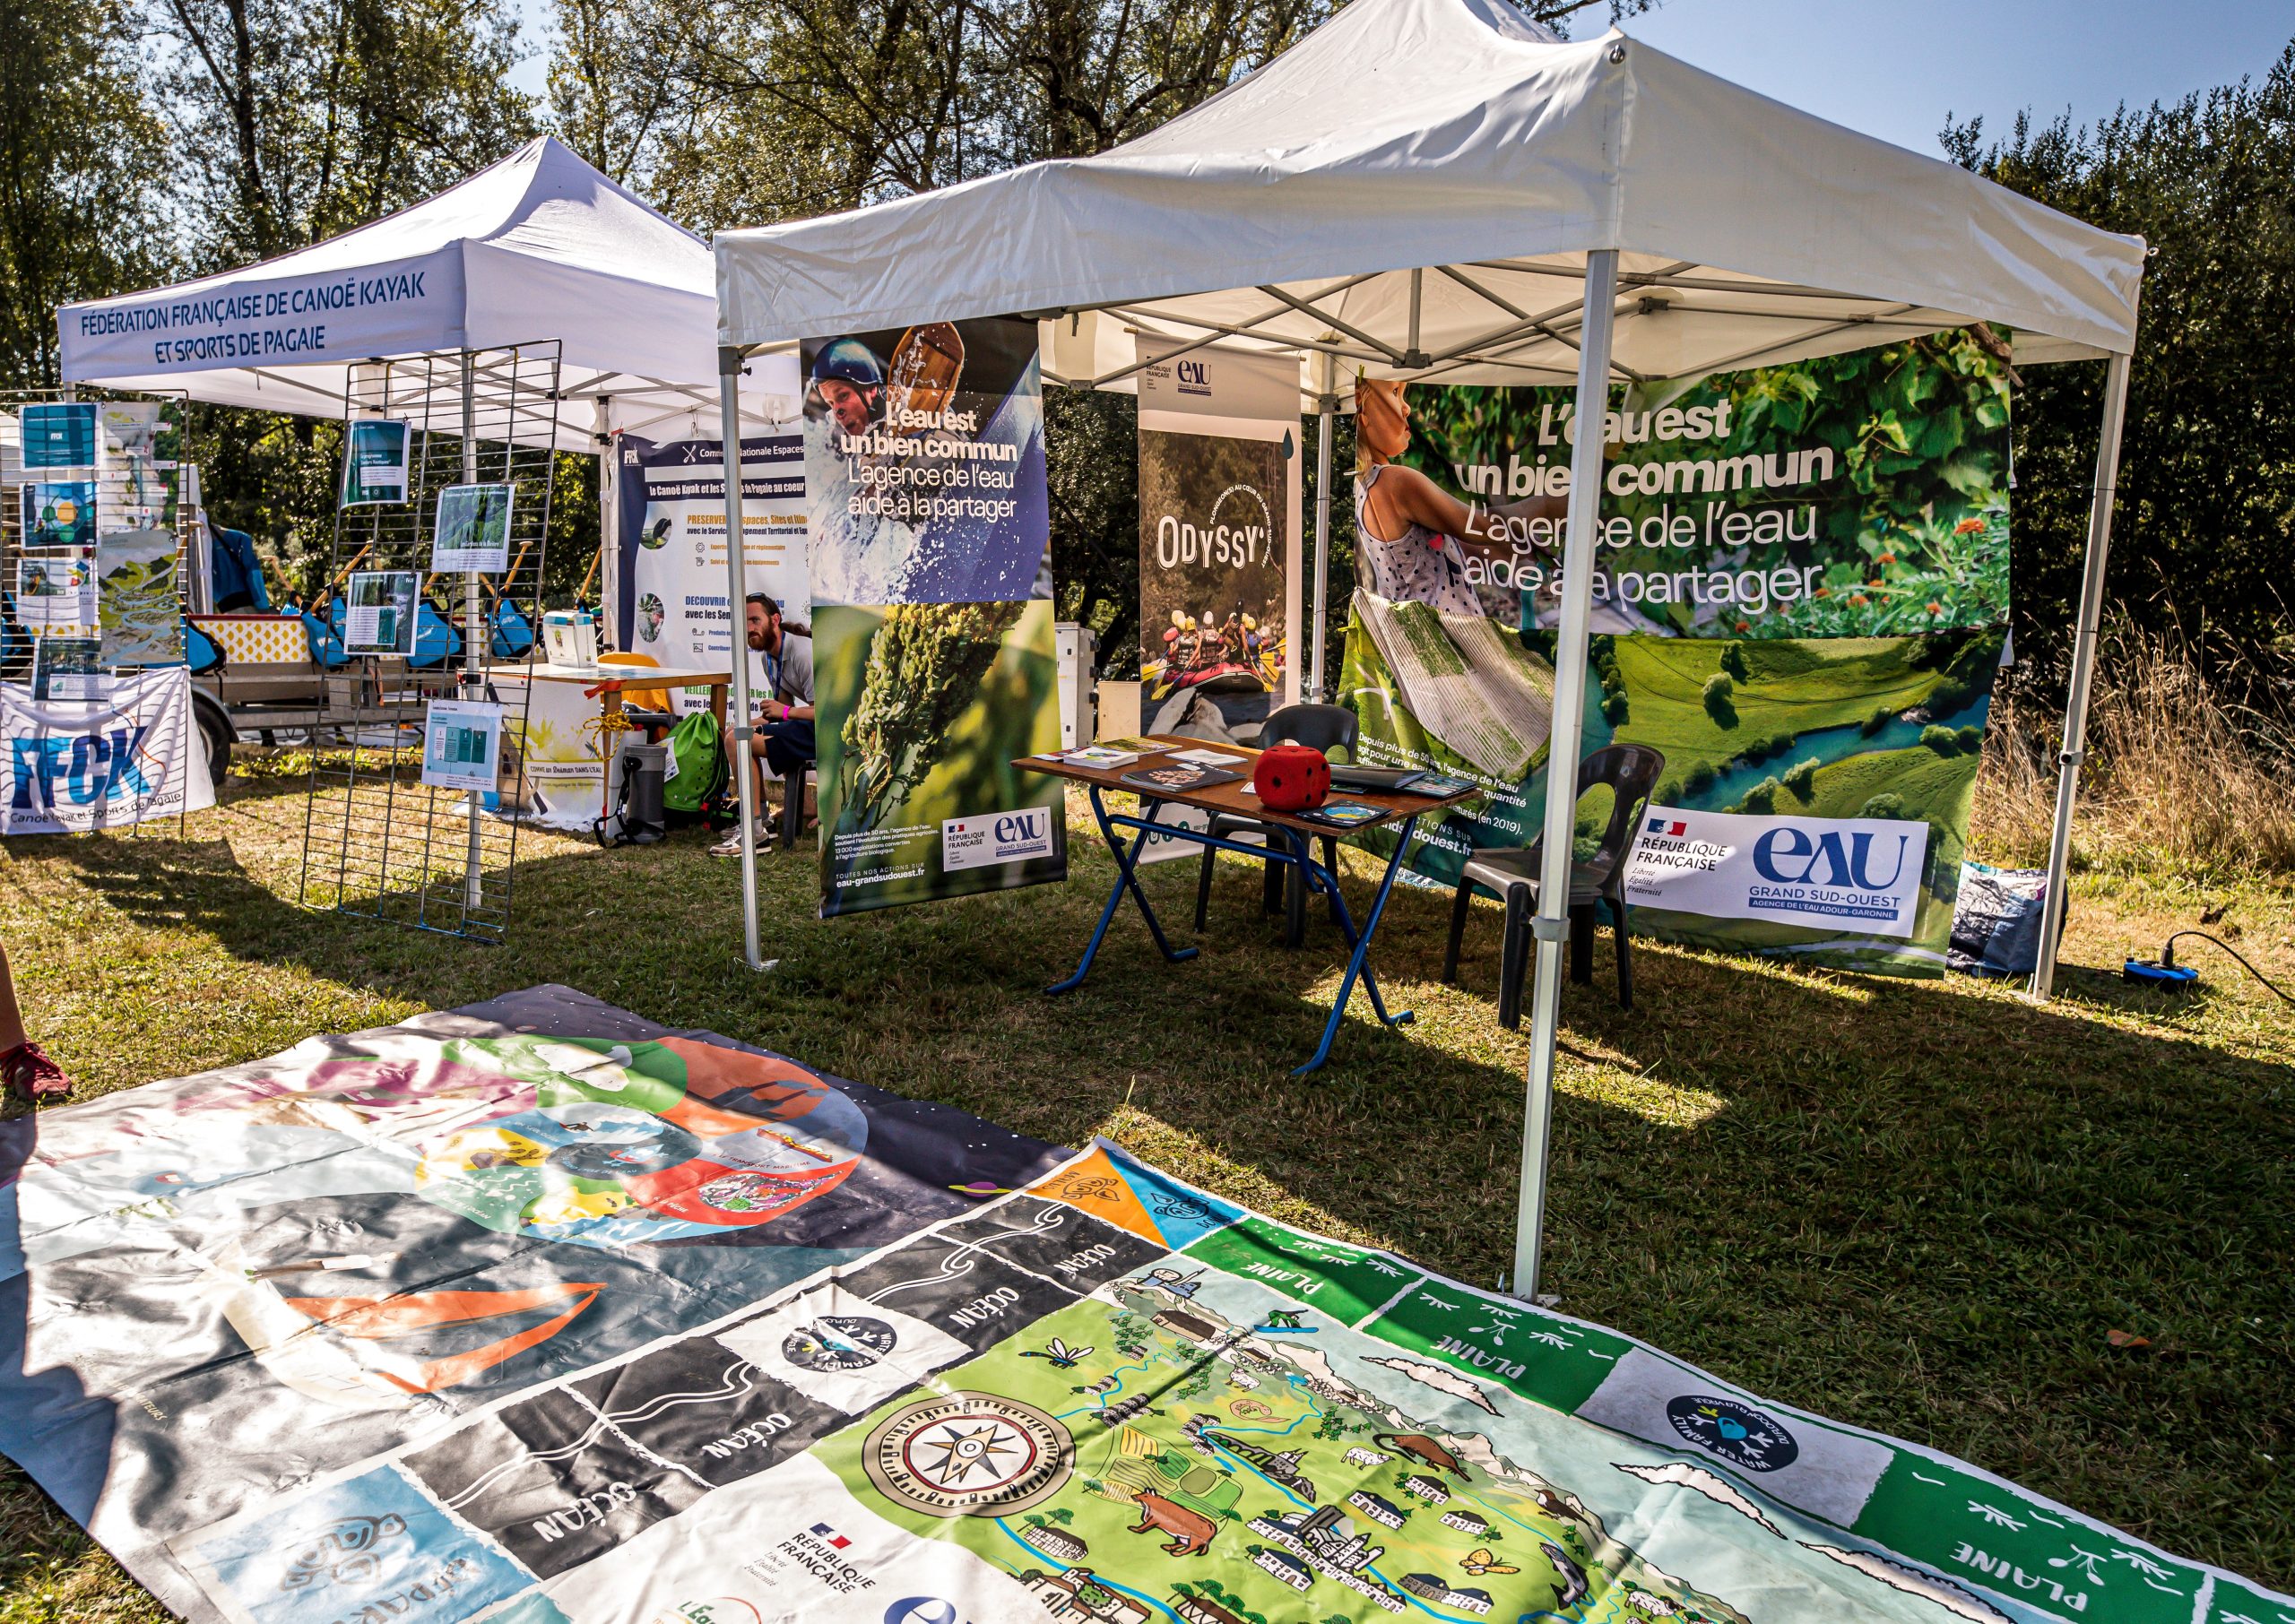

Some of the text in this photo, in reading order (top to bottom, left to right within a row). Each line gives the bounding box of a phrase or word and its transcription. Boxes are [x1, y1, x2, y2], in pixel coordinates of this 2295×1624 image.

[82, 272, 425, 336] FÉDÉRATION FRANÇAISE DE CANOË KAYAK
[155, 326, 325, 363] ET SPORTS DE PAGAIE
[886, 401, 977, 431] L'eau est
[1655, 398, 1732, 442] est
[841, 430, 1018, 462] un bien commun
[848, 458, 1014, 491] L'agence de l'eau
[1454, 446, 1833, 497] un bie commun
[701, 484, 709, 494] et
[1256, 494, 1263, 503] DU
[847, 491, 1018, 523] aide à la partager
[1640, 503, 1696, 548] de
[1706, 500, 1816, 547] l'eau
[1464, 549, 1823, 616] aide partager
[685, 610, 703, 618] avec
[705, 610, 716, 619] les
[684, 700, 702, 708] avec
[12, 726, 152, 808] FFCK
[1357, 744, 1369, 756] agit
[1370, 750, 1390, 763] pour
[1391, 756, 1410, 768] une
[1484, 789, 1526, 808] quantité
[1358, 731, 1384, 749] Depuis
[1385, 743, 1406, 756] plus
[1407, 749, 1419, 759] de
[1420, 752, 1429, 762] 50
[1443, 762, 1477, 782] l'agence
[1479, 775, 1492, 785] de
[1494, 778, 1519, 793] l'eau
[948, 831, 985, 842] RÉPUBLIQUE
[1416, 816, 1472, 842] CTIONS SUR
[1493, 816, 1523, 835] 2019).
[948, 839, 983, 849] FRANÇAISE
[1016, 840, 1046, 849] SUD-OUEST
[1641, 837, 1728, 857] RÉPUBLIQUE
[836, 871, 862, 879] TOUTES
[863, 868, 878, 877] NOS
[879, 864, 910, 873] ACTIONS
[1632, 867, 1656, 877] Liberté
[1636, 851, 1717, 871] FRANÇAISE
[836, 868, 925, 888] eau-grandsudouest.fr
[1626, 885, 1662, 896] Fraternité
[1749, 885, 1901, 908] GRAND SUD-OUEST
[1753, 900, 1785, 908] AGENCE
[1798, 903, 1819, 911] L'EAU
[1820, 904, 1894, 919] ADOUR-GARONNE
[1241, 1261, 1326, 1296] PLAINE
[948, 1286, 1020, 1329] OCÉAN
[1429, 1335, 1528, 1381] PLAINE
[702, 1412, 792, 1459] OCÉAN
[1671, 1414, 1772, 1470] WATER FAMILY
[776, 1541, 856, 1594] FRANÇAISE
[792, 1533, 876, 1590] RÉPUBLIQUE
[1950, 1541, 2089, 1612] PLAINE
